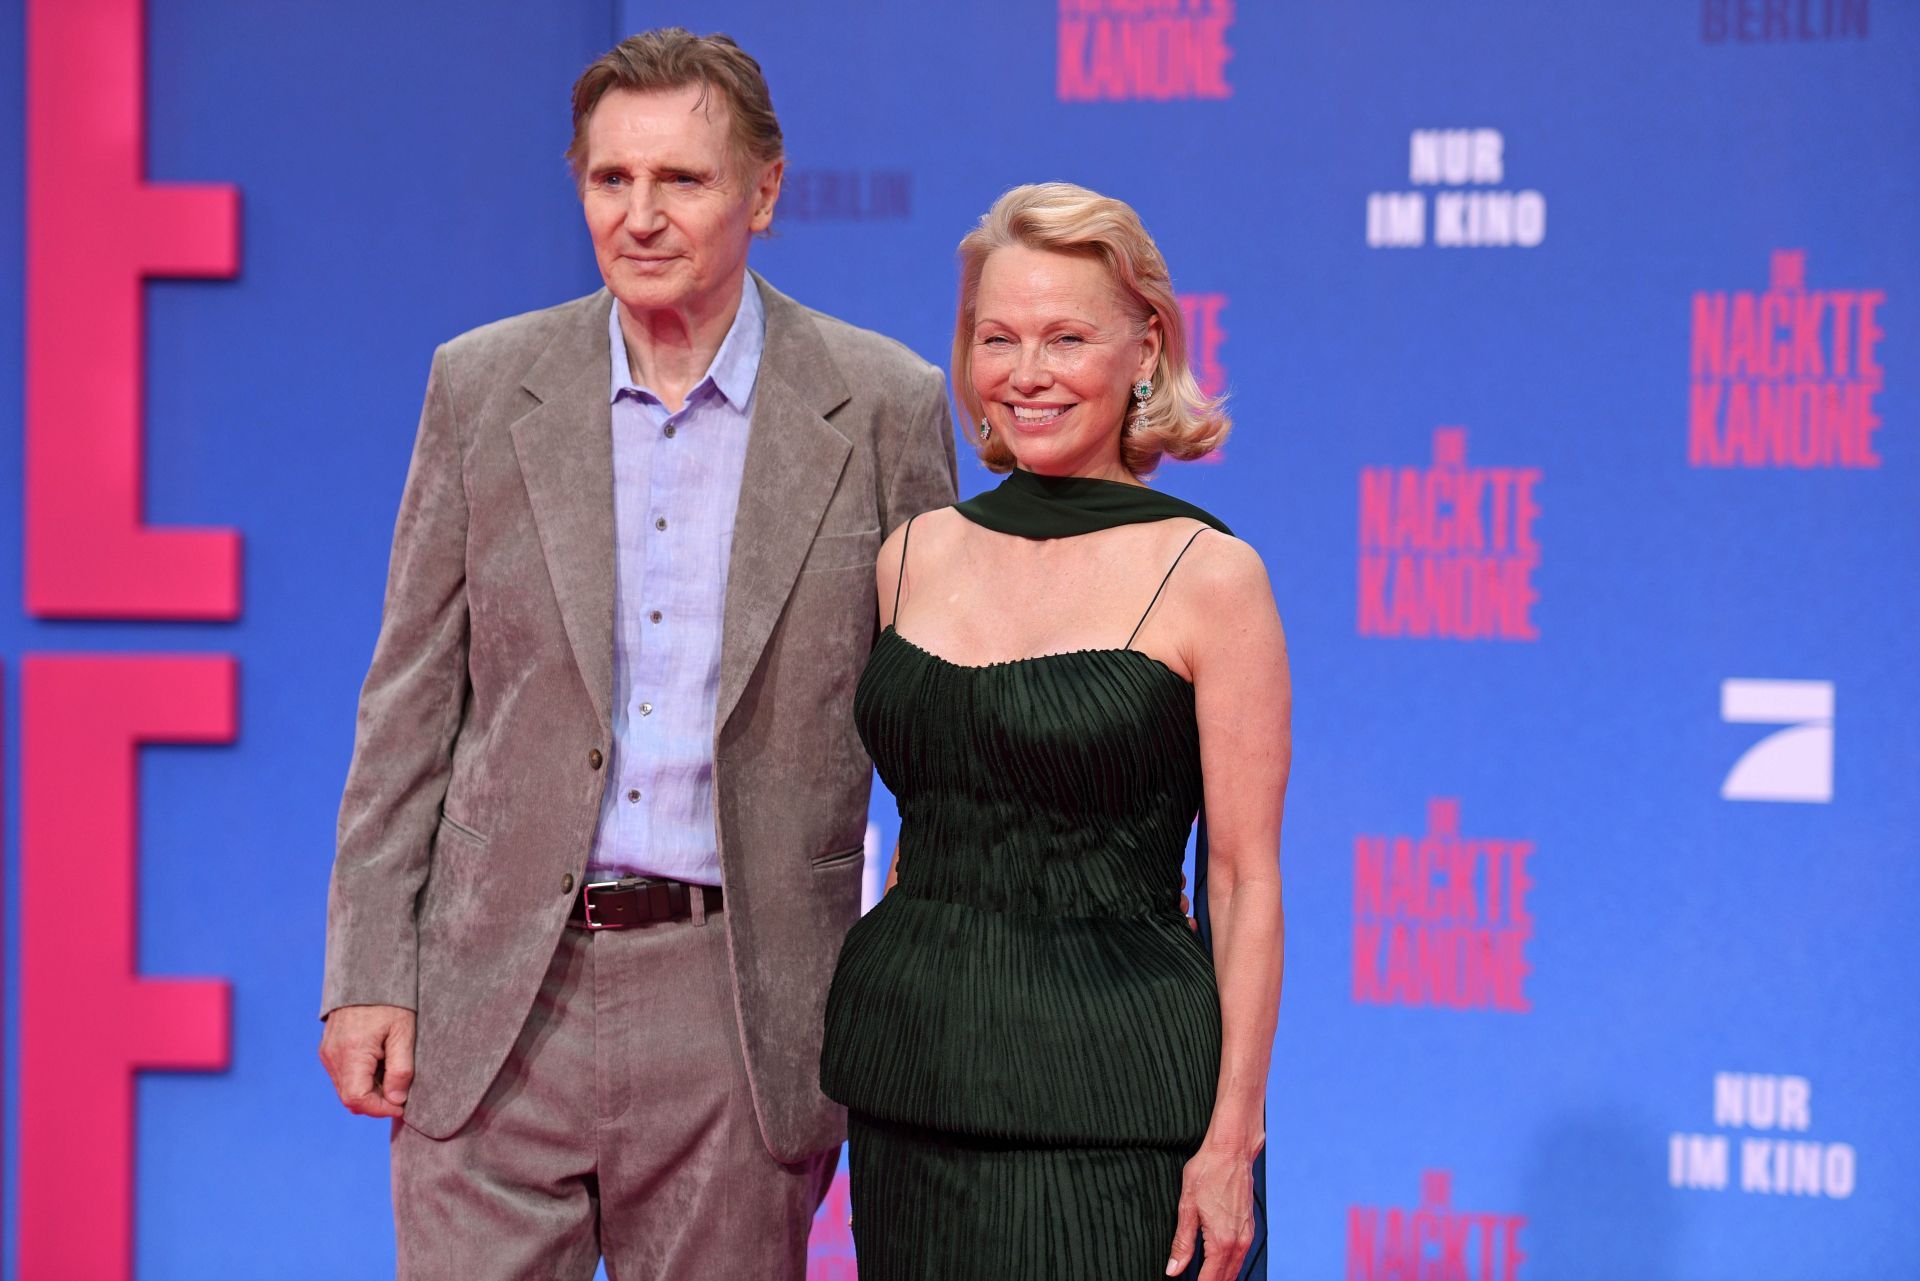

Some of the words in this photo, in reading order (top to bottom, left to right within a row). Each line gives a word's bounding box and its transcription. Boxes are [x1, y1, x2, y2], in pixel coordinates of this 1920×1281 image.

[1057, 17, 1236, 101] KANONE
[1702, 0, 1869, 44] BERLIN
[1410, 128, 1504, 185] NUR
[1366, 191, 1426, 248] IM
[1435, 190, 1547, 248] KINO
[1691, 289, 1884, 377] NACKTE
[1689, 380, 1882, 468] KANONE
[1359, 466, 1542, 551] NACKTE
[1357, 553, 1541, 641] KANONE
[1353, 835, 1536, 922] NACKTE
[1353, 923, 1535, 1012] KANONE
[1713, 1071, 1811, 1132] NUR
[1668, 1132, 1729, 1191] IM
[1740, 1136, 1857, 1199] KINO
